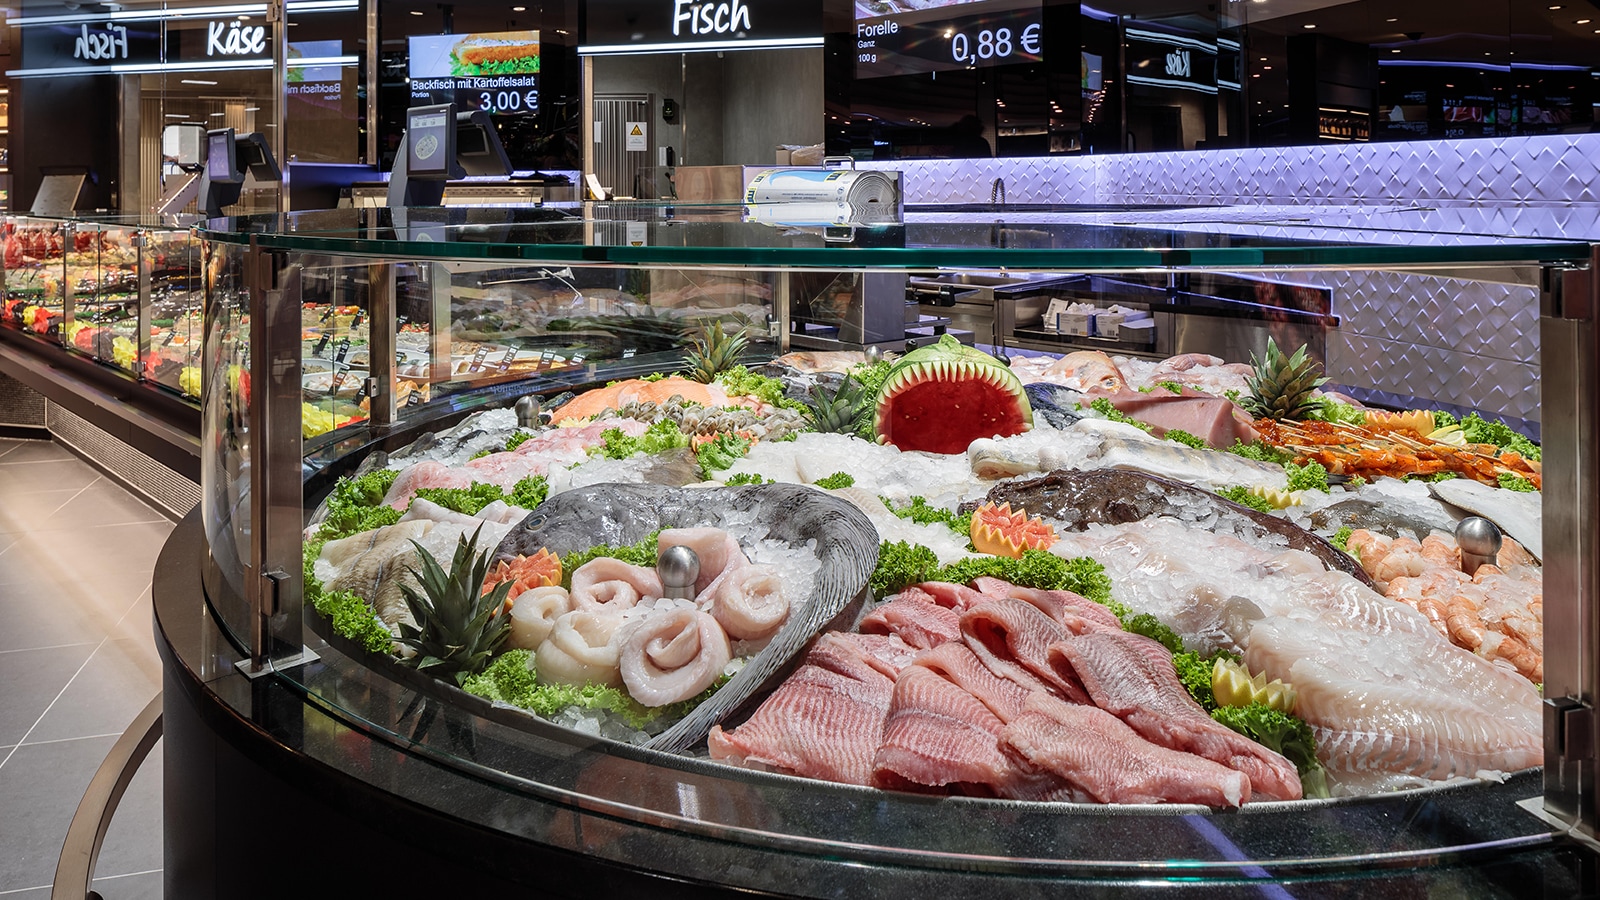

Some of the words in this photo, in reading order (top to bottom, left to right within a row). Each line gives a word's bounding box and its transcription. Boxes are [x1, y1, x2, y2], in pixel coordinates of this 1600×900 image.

[673, 0, 751, 36] Fisch
[207, 21, 266, 56] Käse
[857, 20, 899, 38] Forelle
[857, 40, 875, 49] Ganz
[951, 28, 1013, 65] 0,88
[1020, 23, 1041, 54] €
[858, 53, 870, 62] 100
[871, 54, 877, 63] g
[412, 79, 455, 90] Backfisch
[457, 78, 471, 89] mit
[473, 76, 535, 88] Kartoffelsalat
[480, 91, 520, 113] 3,00
[524, 90, 539, 109] €
